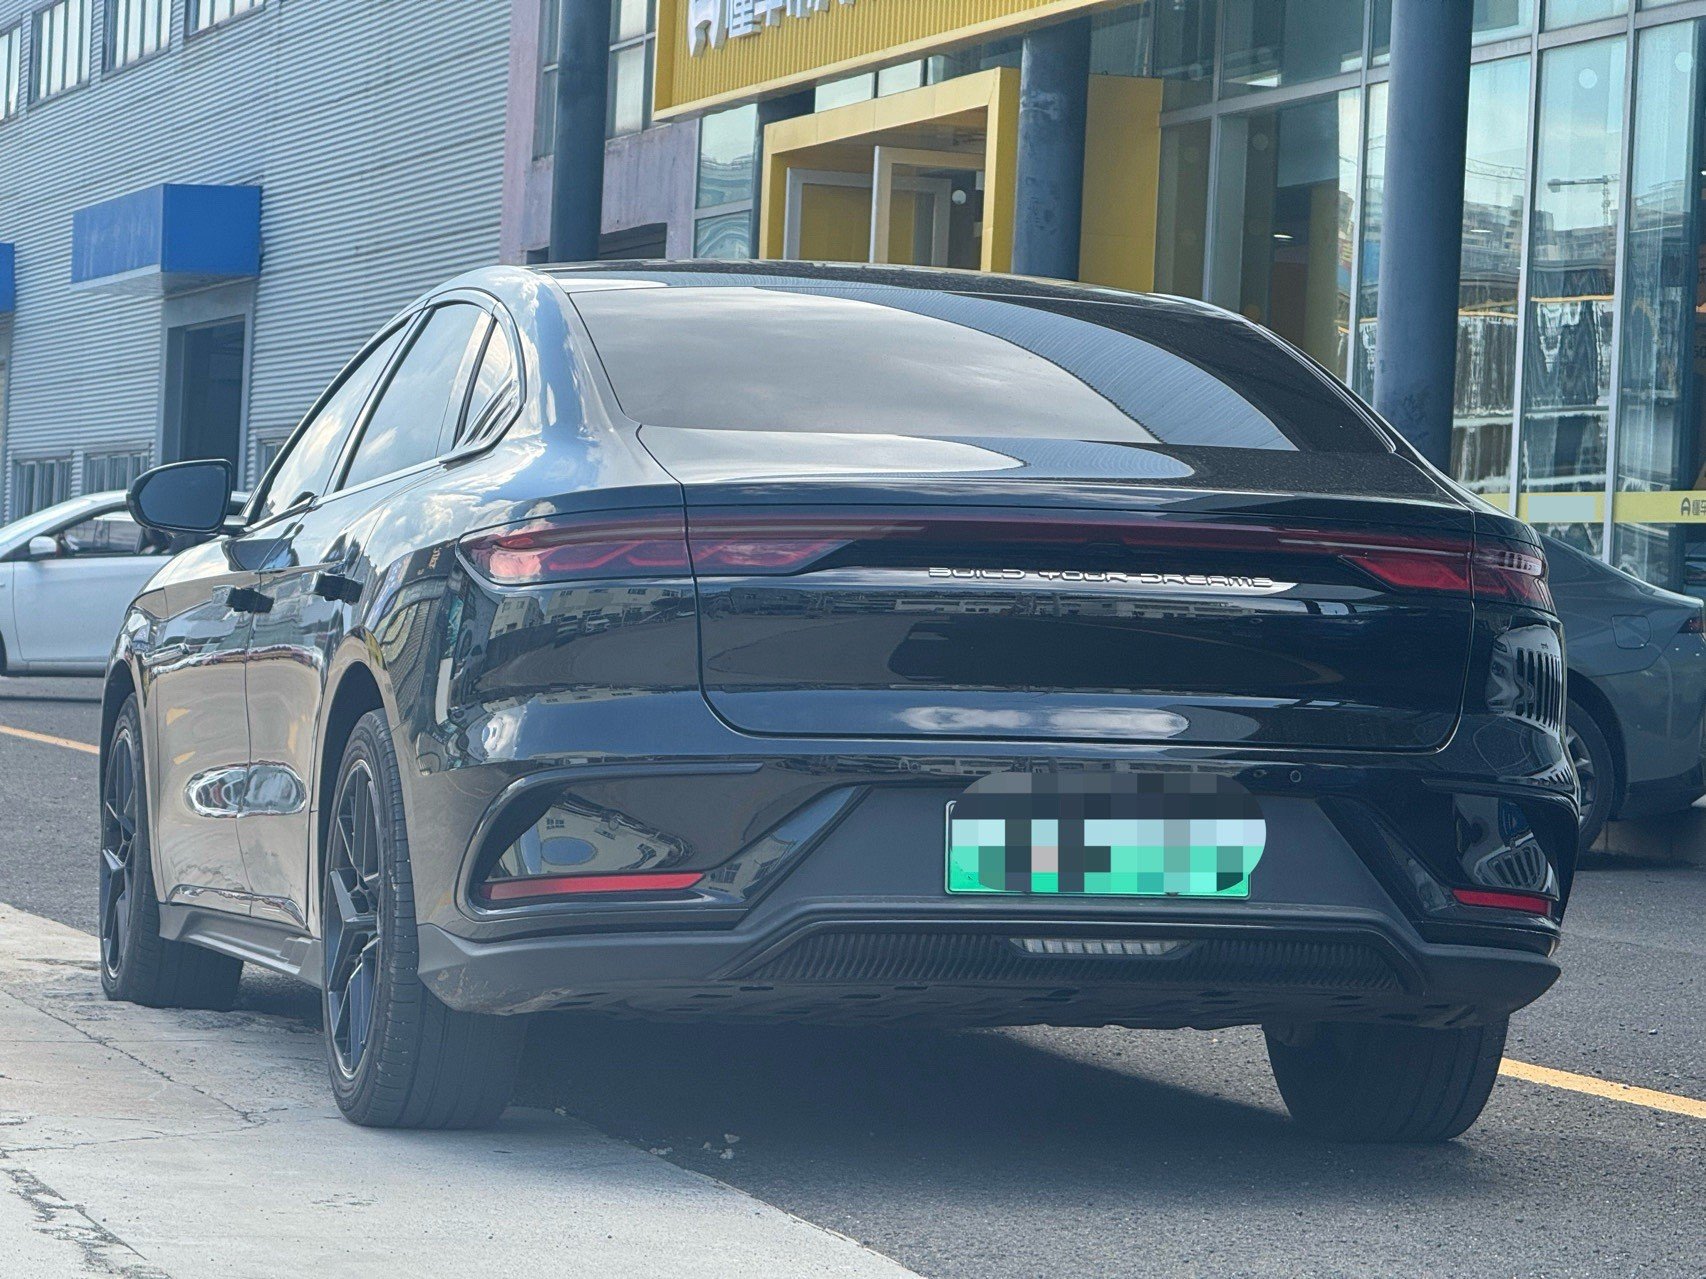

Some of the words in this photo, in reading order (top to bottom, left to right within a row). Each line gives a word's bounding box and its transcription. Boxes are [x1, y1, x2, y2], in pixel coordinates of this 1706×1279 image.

[928, 567, 1026, 579] BUILD
[1038, 570, 1128, 583] YOUR
[1140, 573, 1274, 588] DREAMS
